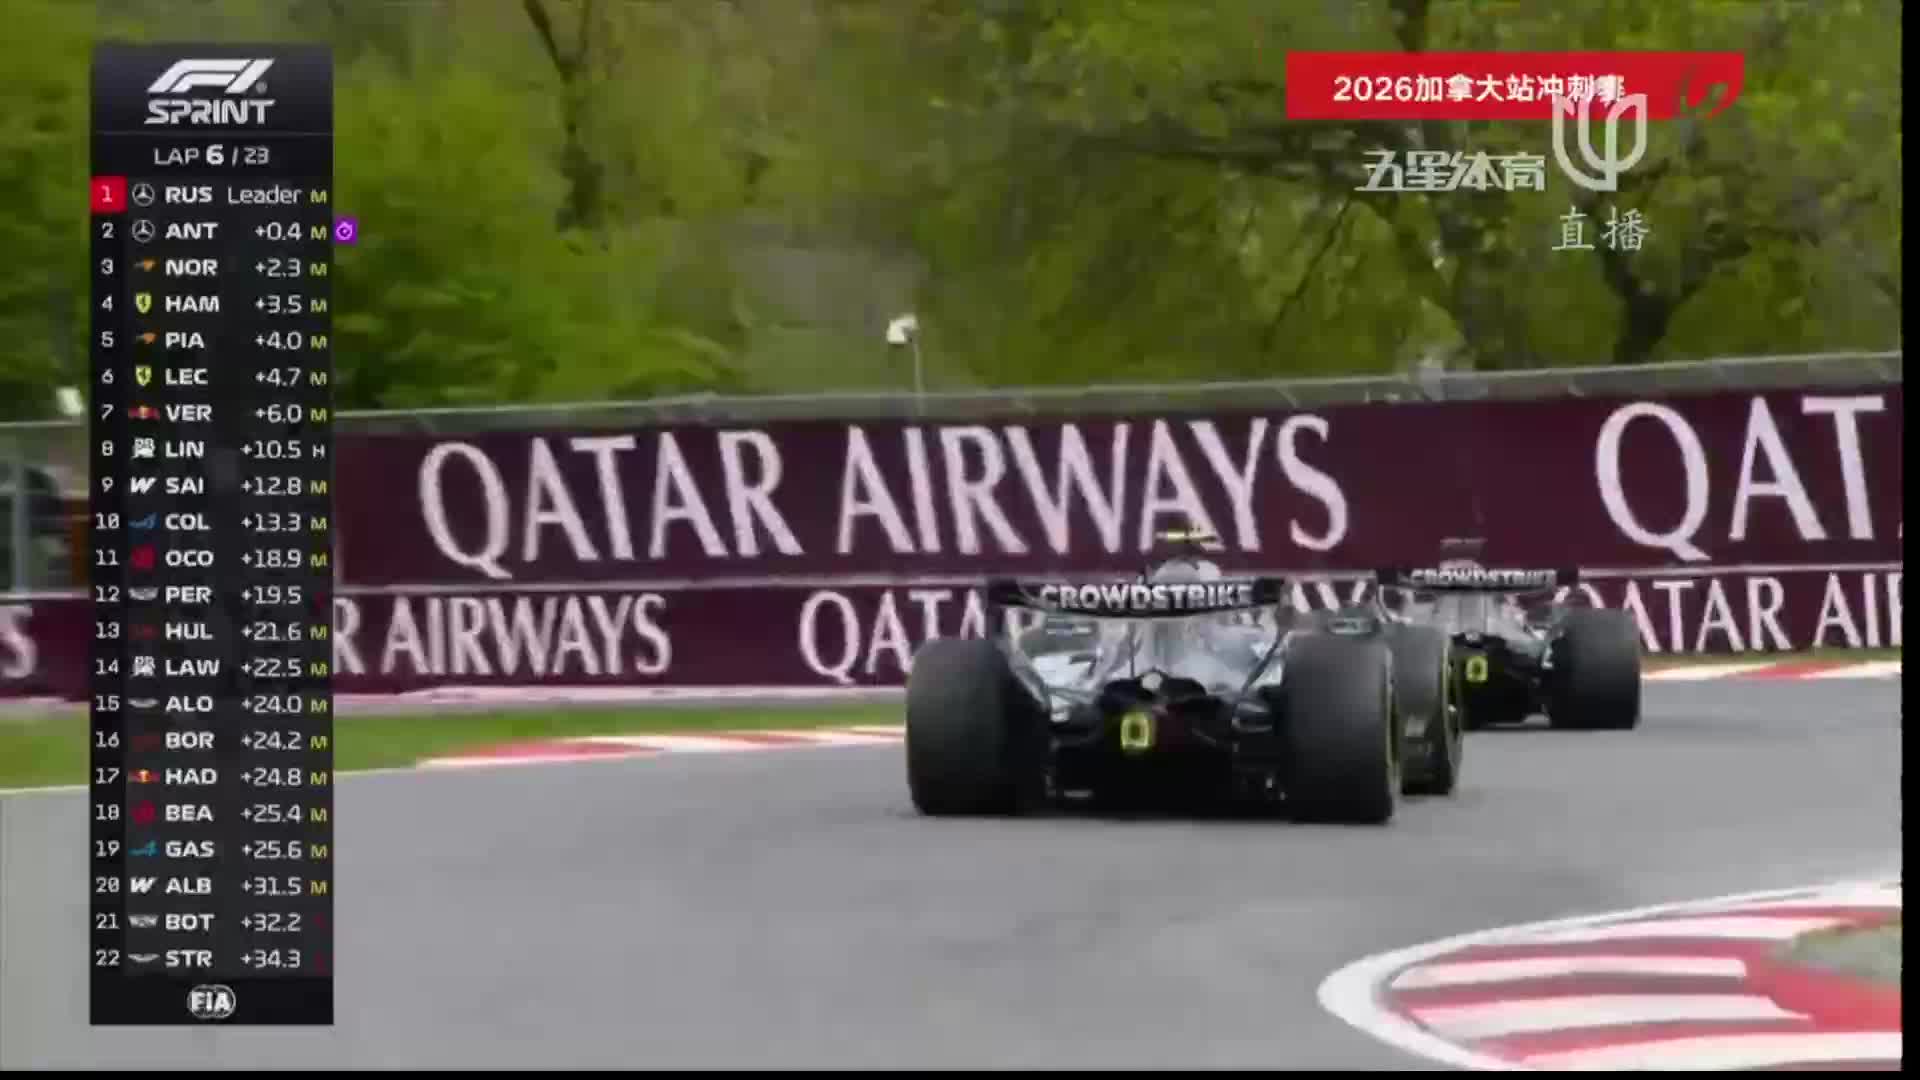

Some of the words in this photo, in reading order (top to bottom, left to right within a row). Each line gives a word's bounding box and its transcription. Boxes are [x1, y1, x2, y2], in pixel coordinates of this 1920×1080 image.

[418, 428, 801, 579] QATAR
[836, 415, 1348, 556] AIRWAYS
[1595, 395, 1902, 562] QAT
[381, 592, 672, 675] AIRWAYS
[799, 589, 987, 683] QATA
[1040, 583, 1254, 609] CROWDSTRIKE
